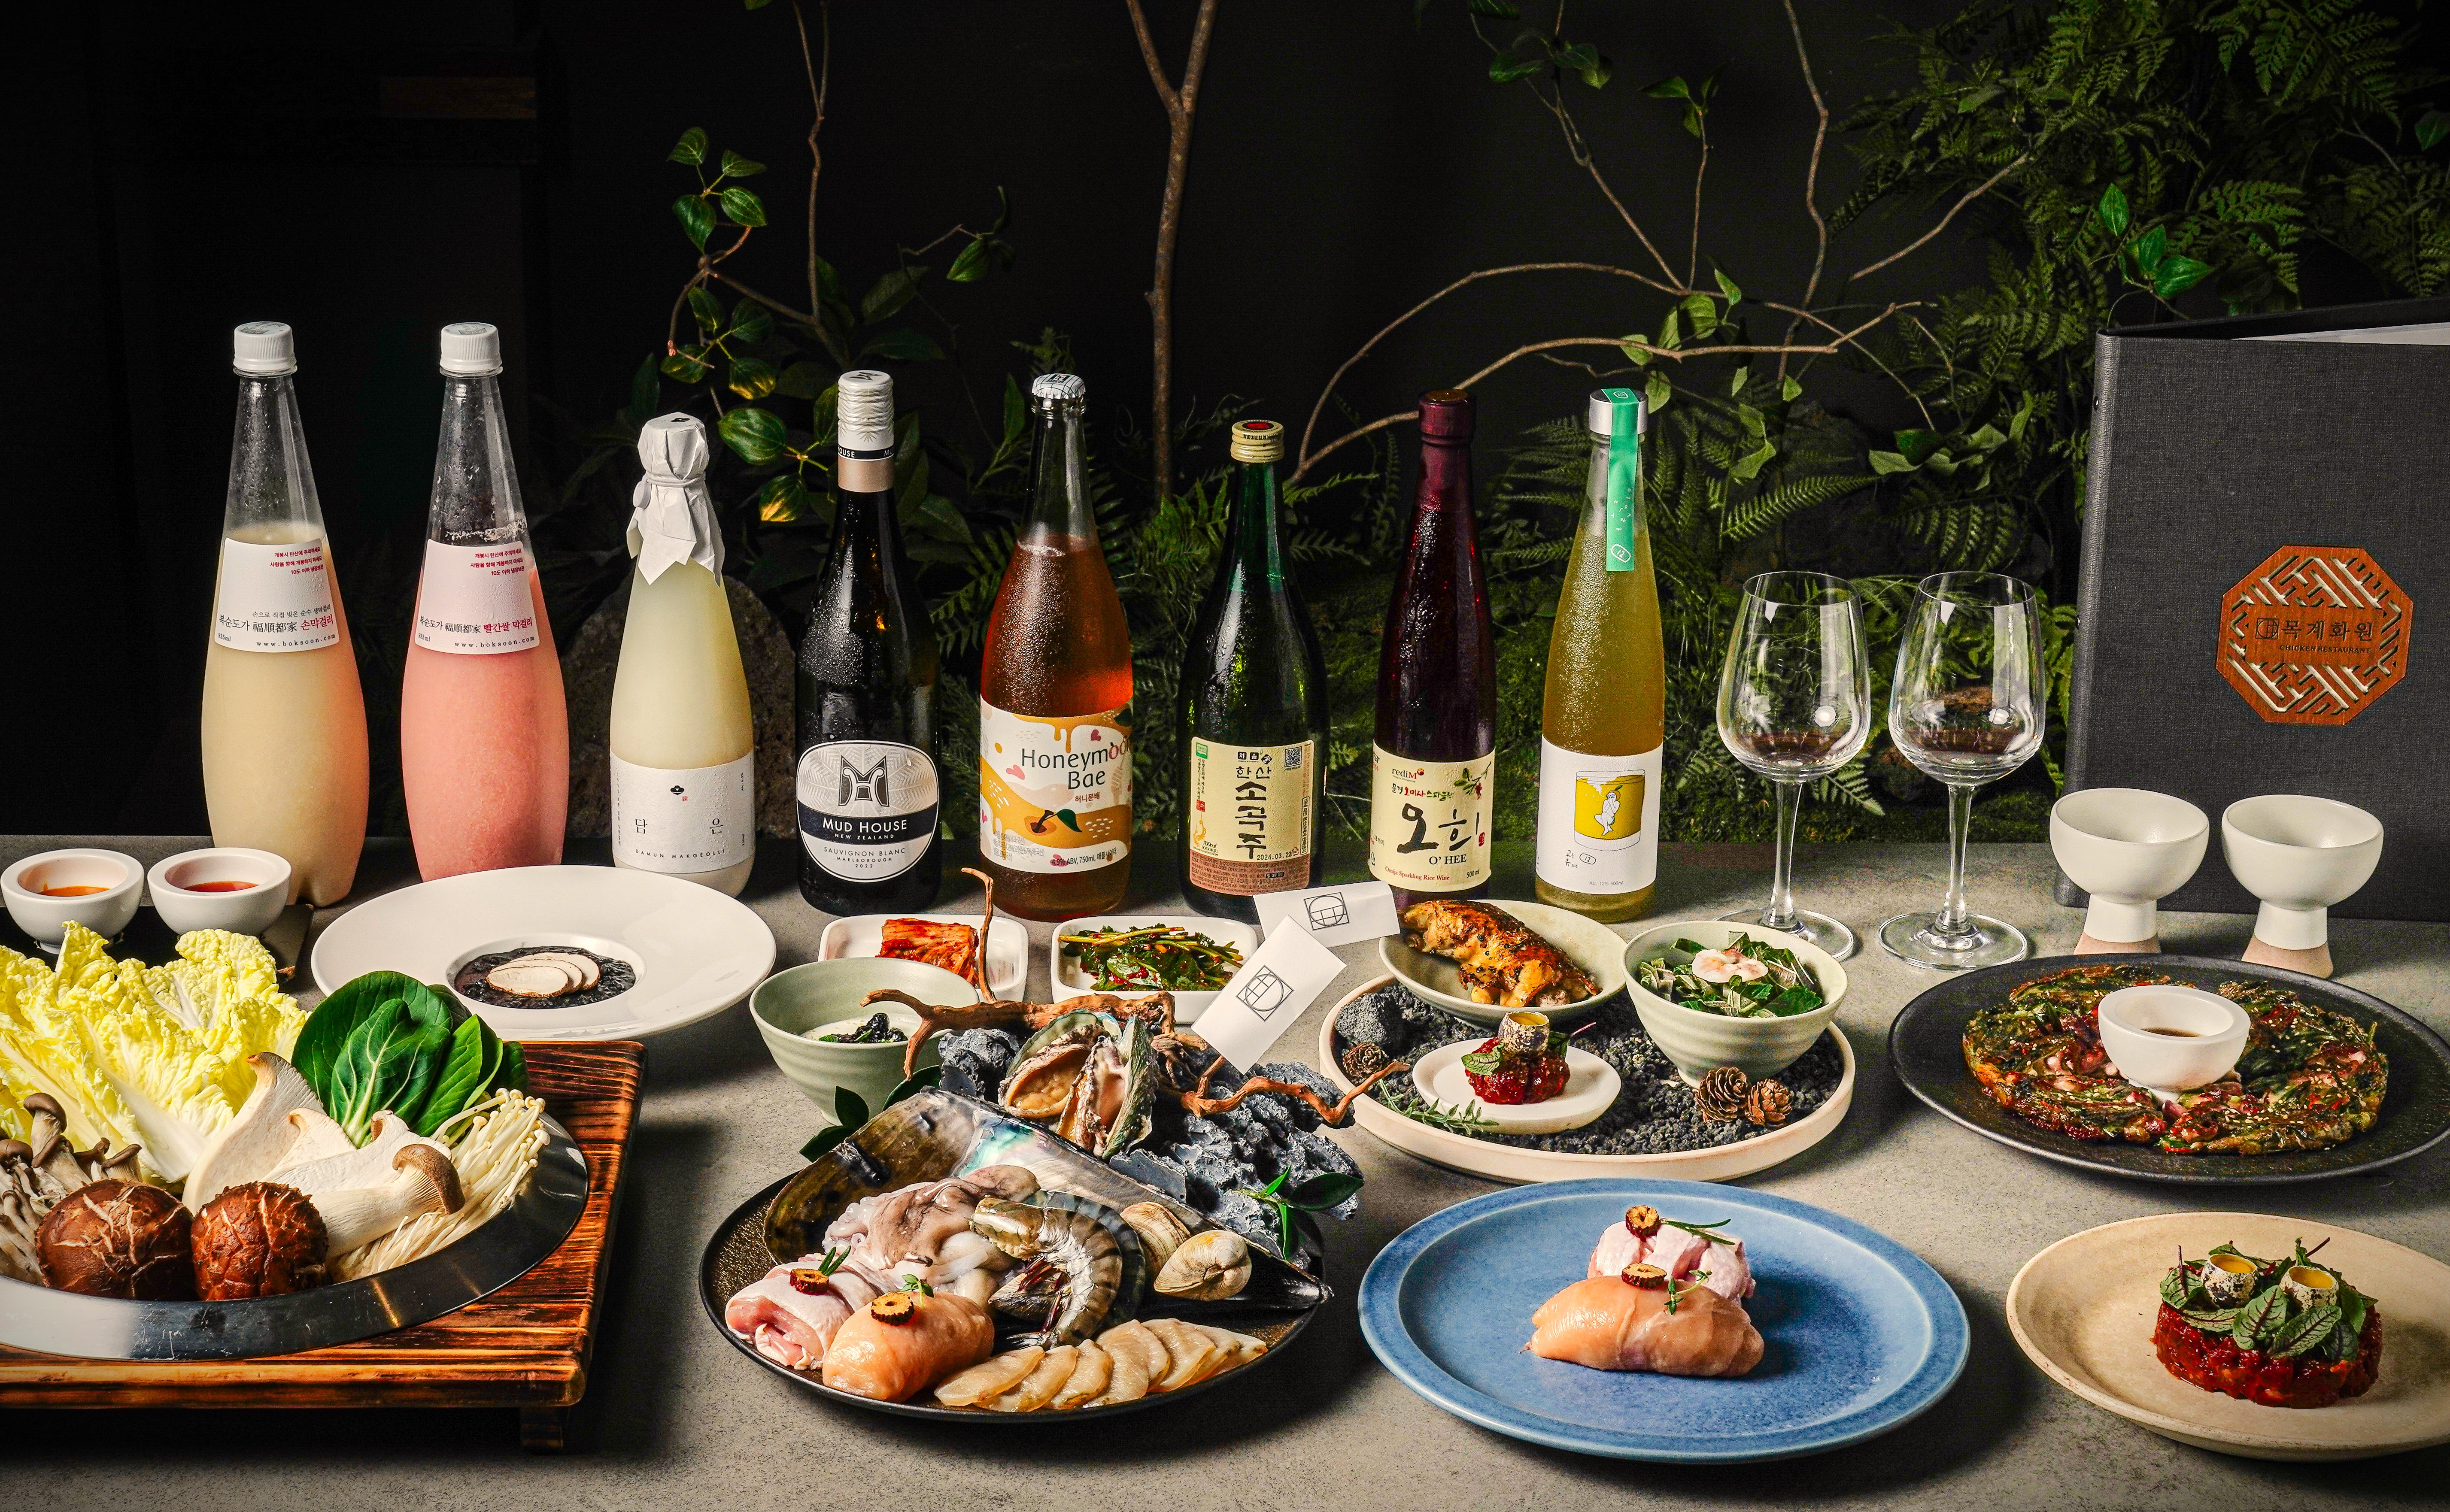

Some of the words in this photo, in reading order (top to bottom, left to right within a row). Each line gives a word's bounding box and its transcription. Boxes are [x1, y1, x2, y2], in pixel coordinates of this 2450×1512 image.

[304, 546, 321, 555] 주의하세요
[504, 548, 522, 556] 주의하세요
[313, 604, 331, 615] 생막걸리
[219, 615, 250, 631] 복순도가
[252, 621, 297, 633] 福順都家
[301, 614, 333, 630] 손막걸리
[420, 615, 443, 630] 복순도가
[445, 623, 481, 633] 福順都家
[483, 622, 510, 633] 빨간쌀
[512, 617, 532, 630] 막걸리
[2281, 620, 2373, 642] 목계화원
[218, 633, 231, 642] 935ml
[256, 633, 336, 647] www.boksoon.com
[418, 633, 430, 642] 935ml
[455, 636, 534, 648] www.boksoon.com
[1236, 766, 1272, 779] 한산
[1392, 768, 1417, 779] rediM
[1068, 770, 1106, 790] Bae
[1075, 792, 1100, 803] 허니문배
[1391, 783, 1403, 794] 문경
[1404, 786, 1426, 797] 오미자
[1427, 790, 1454, 801] 스파클링
[823, 817, 853, 832] MUD
[859, 819, 907, 833] HOUSE
[1235, 781, 1266, 859] 소곡주
[635, 818, 648, 835] 담
[709, 818, 724, 835] 은
[635, 849, 664, 858] DAMUN
[823, 846, 874, 856] SAUVIGNON
[879, 848, 906, 856] BLANC
[1257, 851, 1292, 861] 2024.03.22
[1080, 855, 1096, 863] 750mL
[1444, 854, 1466, 864] HEE
[1385, 866, 1398, 876] Omija
[1399, 870, 1422, 880] Sparkling
